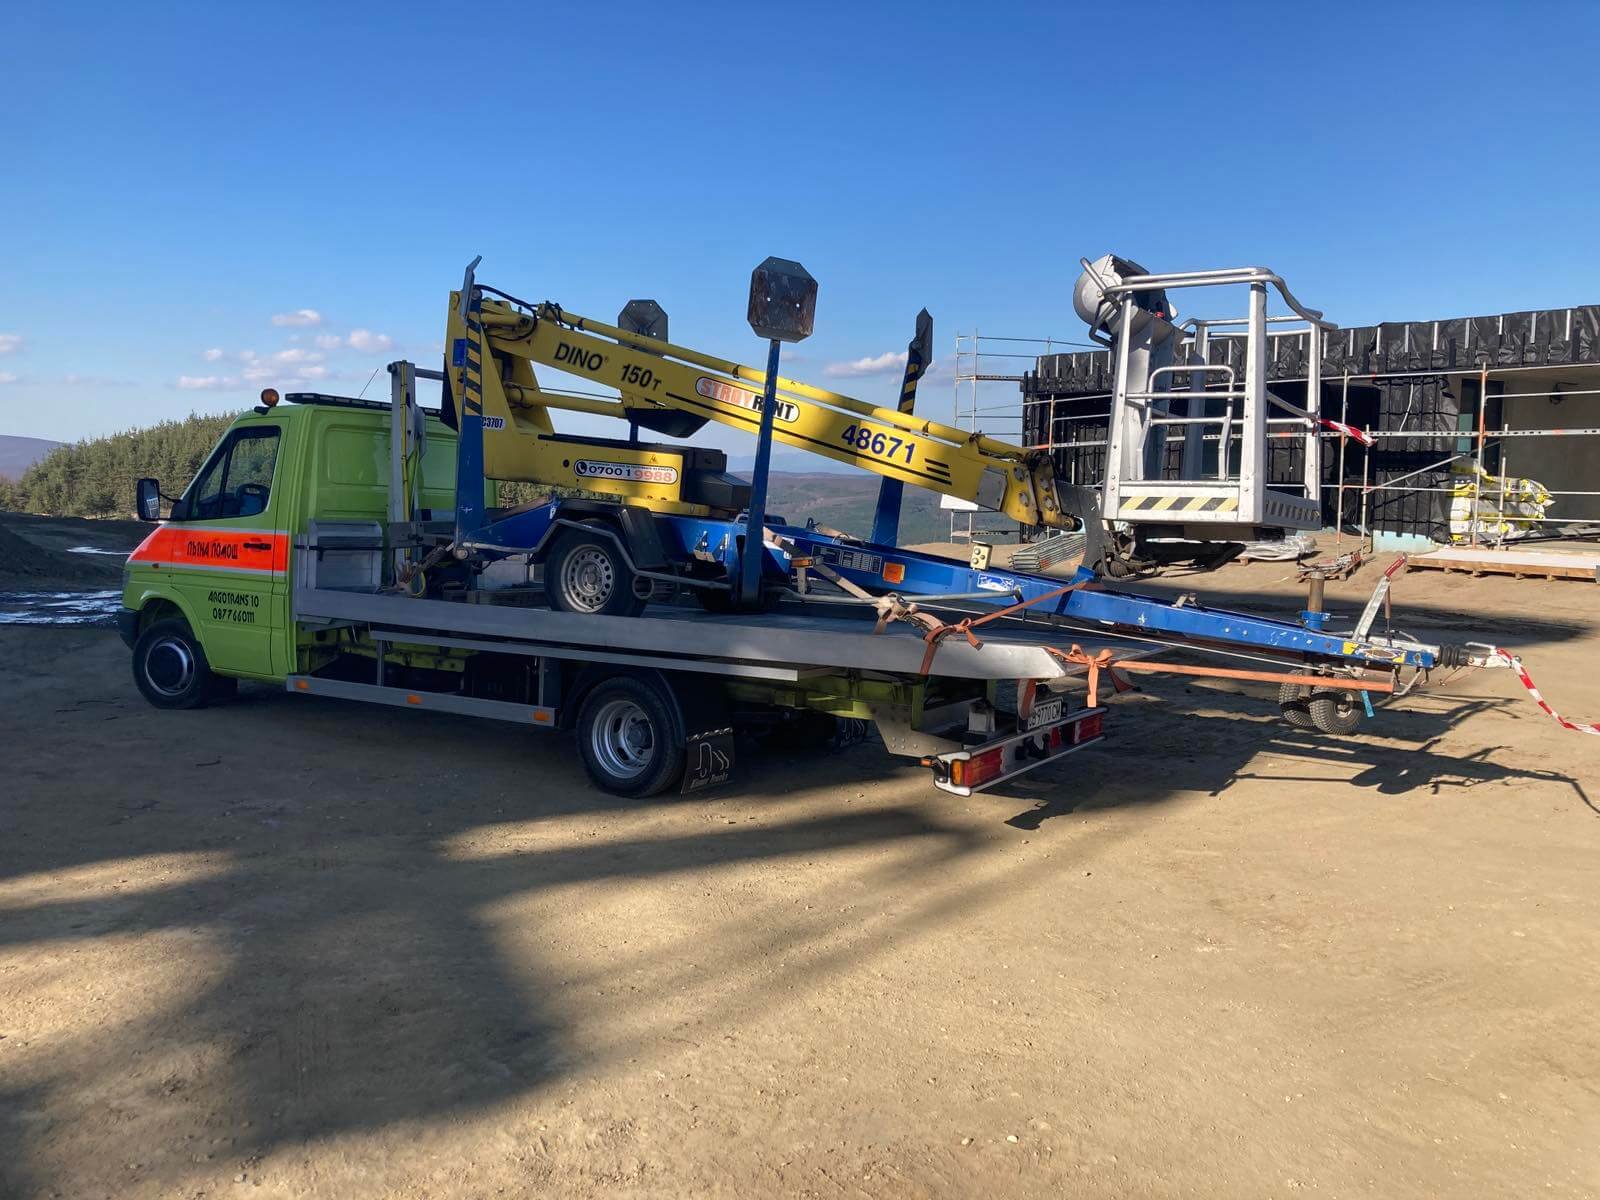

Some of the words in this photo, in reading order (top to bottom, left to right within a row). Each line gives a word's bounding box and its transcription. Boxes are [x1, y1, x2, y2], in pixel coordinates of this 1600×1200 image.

[554, 343, 603, 371] DINO
[841, 424, 916, 464] 48671
[634, 470, 673, 482] 9988
[250, 595, 259, 607] 10
